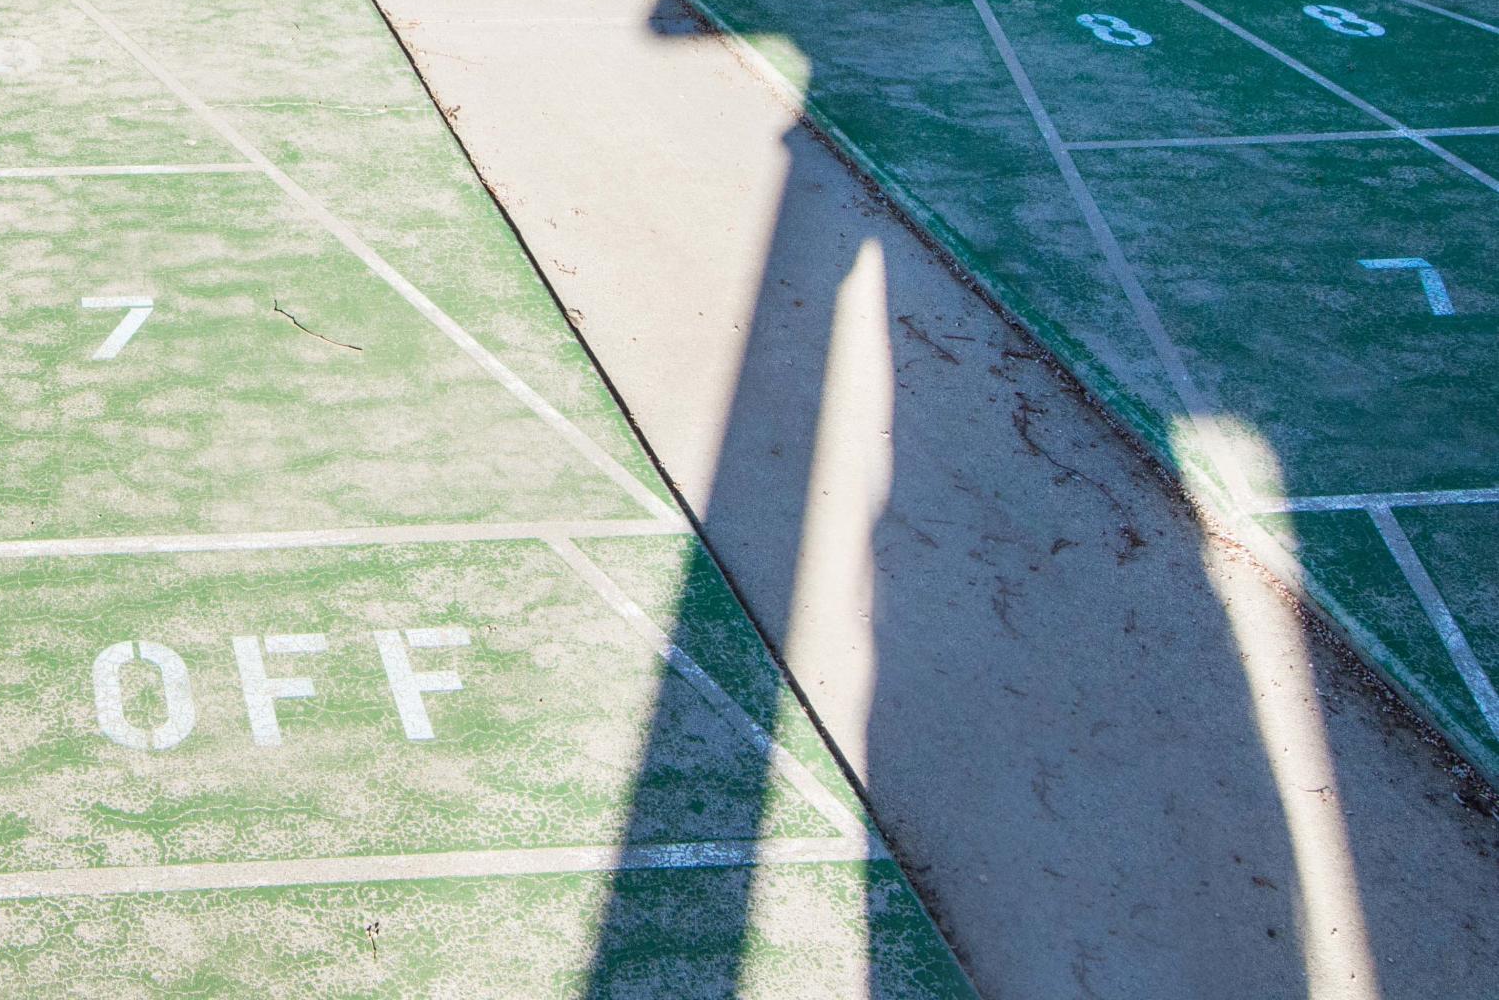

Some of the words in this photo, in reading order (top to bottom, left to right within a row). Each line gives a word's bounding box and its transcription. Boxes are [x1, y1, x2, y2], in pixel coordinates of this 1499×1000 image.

[1077, 13, 1153, 47] 8
[1303, 4, 1386, 37] 8
[1358, 257, 1456, 316] 7
[81, 297, 154, 361] 7
[94, 628, 472, 751] OFF
